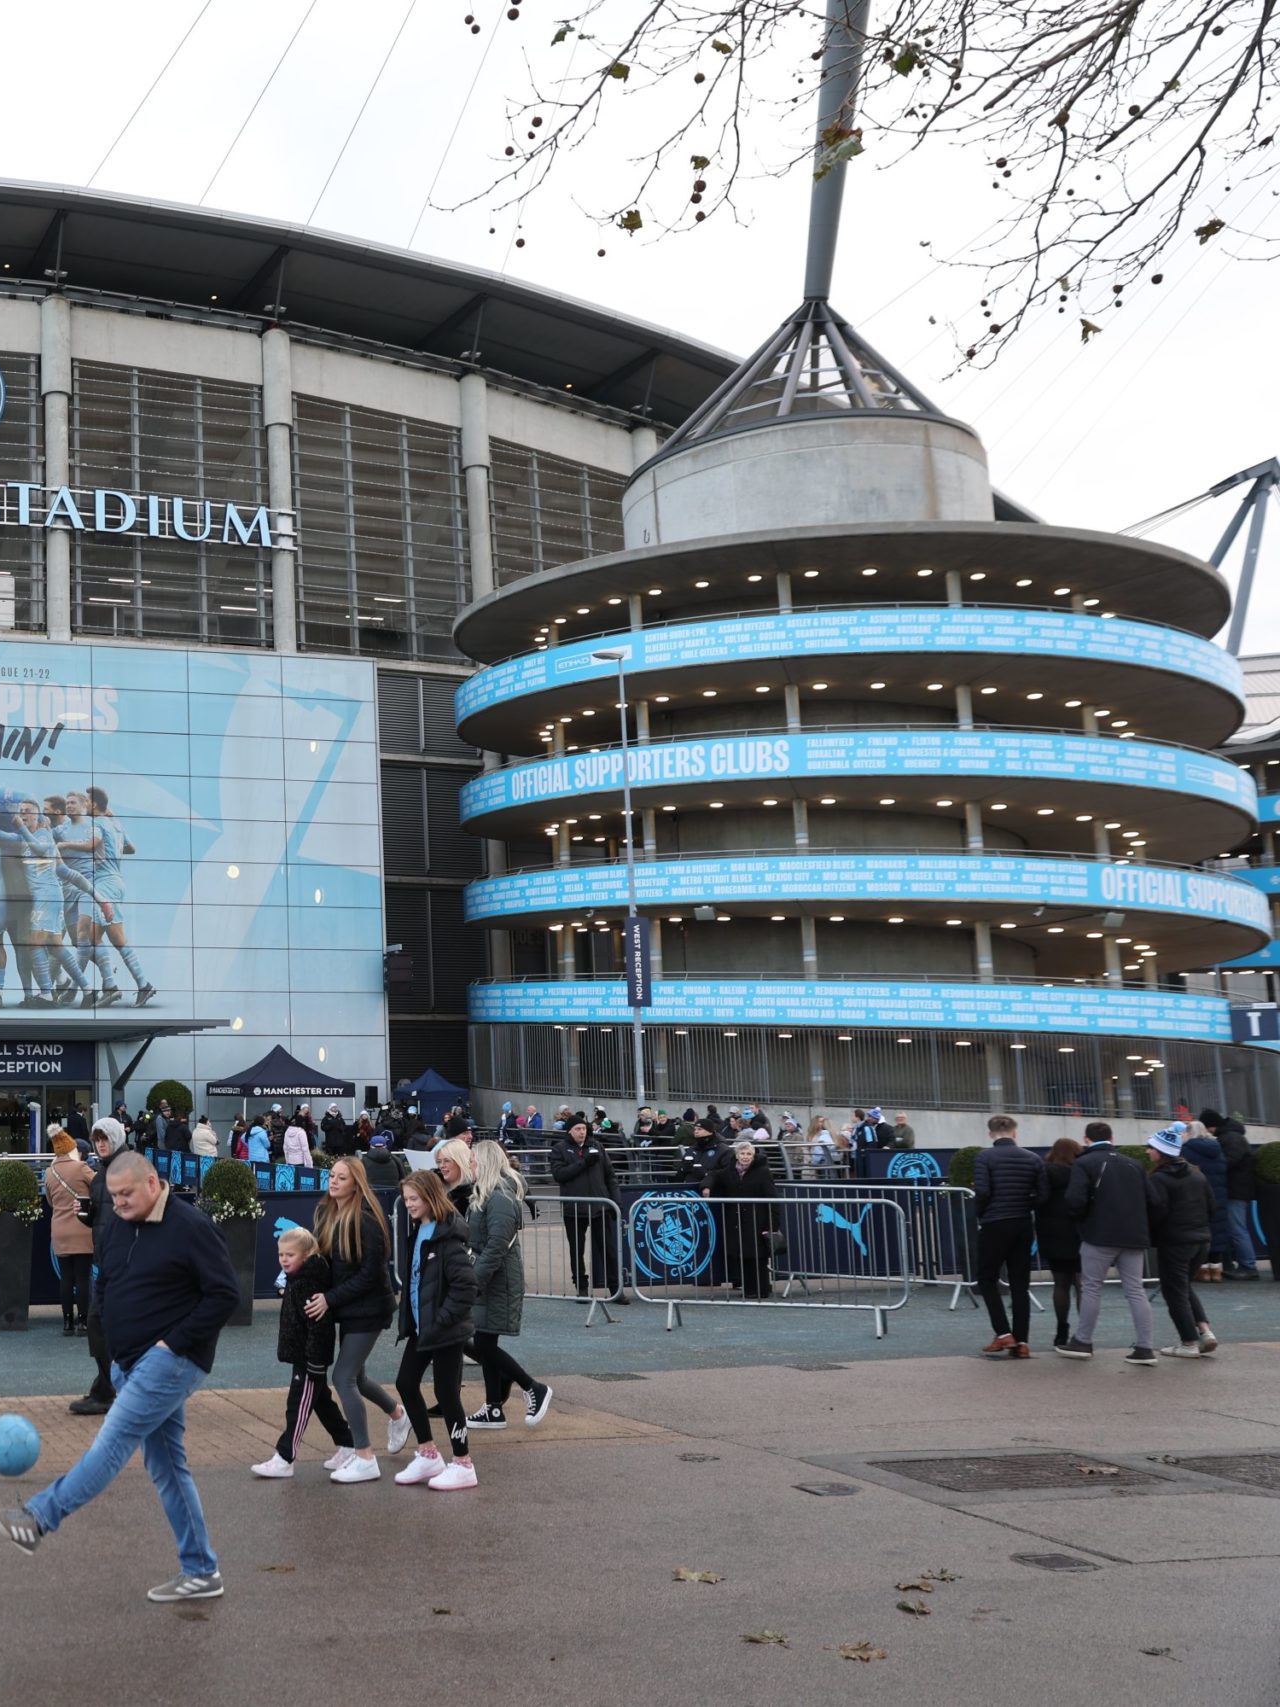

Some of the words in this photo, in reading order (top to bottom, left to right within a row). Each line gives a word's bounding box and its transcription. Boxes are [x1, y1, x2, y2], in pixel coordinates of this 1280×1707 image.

[24, 667, 50, 679] 21-22
[512, 753, 573, 801] OFFICIAL
[574, 743, 705, 791] SUPPORTERS
[710, 739, 790, 776] CLUBS
[1101, 866, 1186, 908] OFFICIAL
[632, 924, 642, 950] WEST
[633, 951, 645, 1001] RECEPTION
[1246, 1011, 1261, 1036] T
[16, 1044, 64, 1056] STAND
[263, 1087, 322, 1096] MANCHESTER
[323, 1087, 344, 1096] CITY
[670, 1261, 695, 1278] CITY
